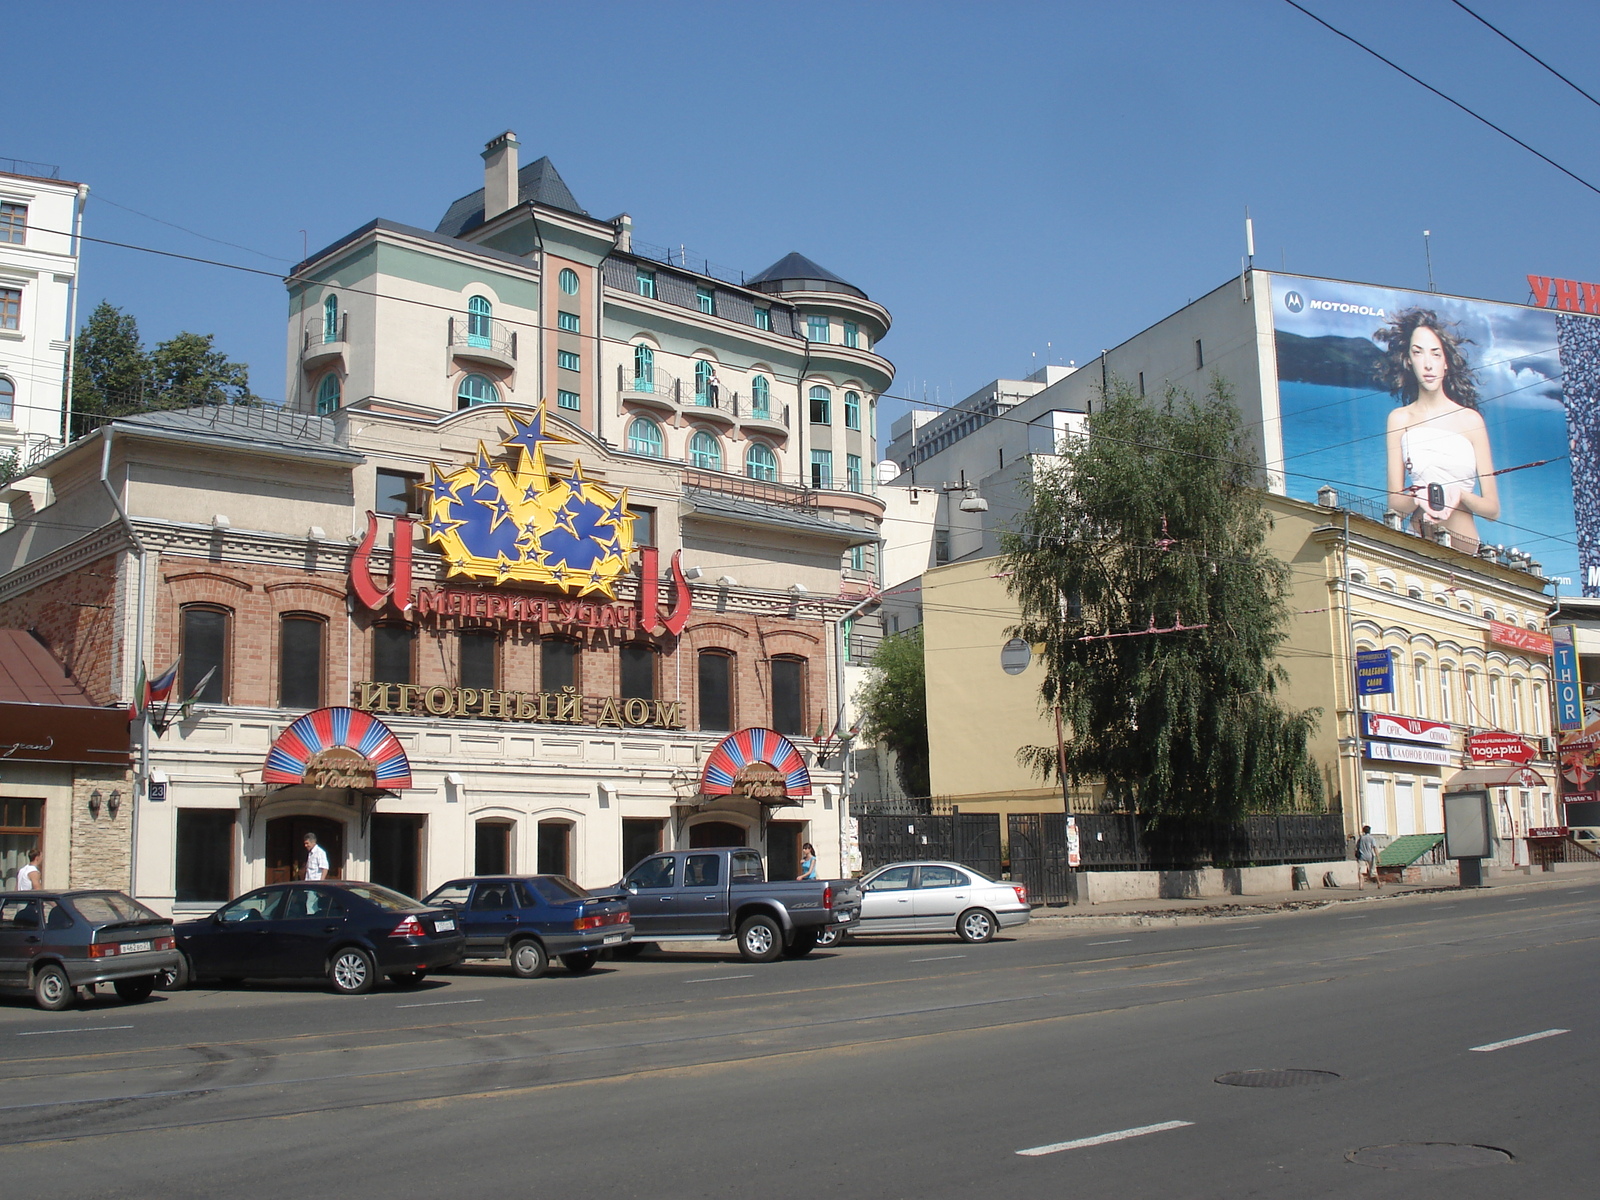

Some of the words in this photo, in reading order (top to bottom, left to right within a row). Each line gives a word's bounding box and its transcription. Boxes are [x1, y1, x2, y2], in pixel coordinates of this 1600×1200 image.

[1310, 299, 1385, 317] MOTOROLA
[1559, 650, 1576, 720] THOR
[358, 681, 583, 722] ИГОРНЫЙ
[597, 696, 682, 730] ДОМ
[3, 735, 54, 757] grand
[1393, 747, 1422, 760] САЛОНОВ
[1423, 751, 1447, 762] ОПТИКИ
[1472, 745, 1523, 759] подарки
[152, 786, 164, 797] 23
